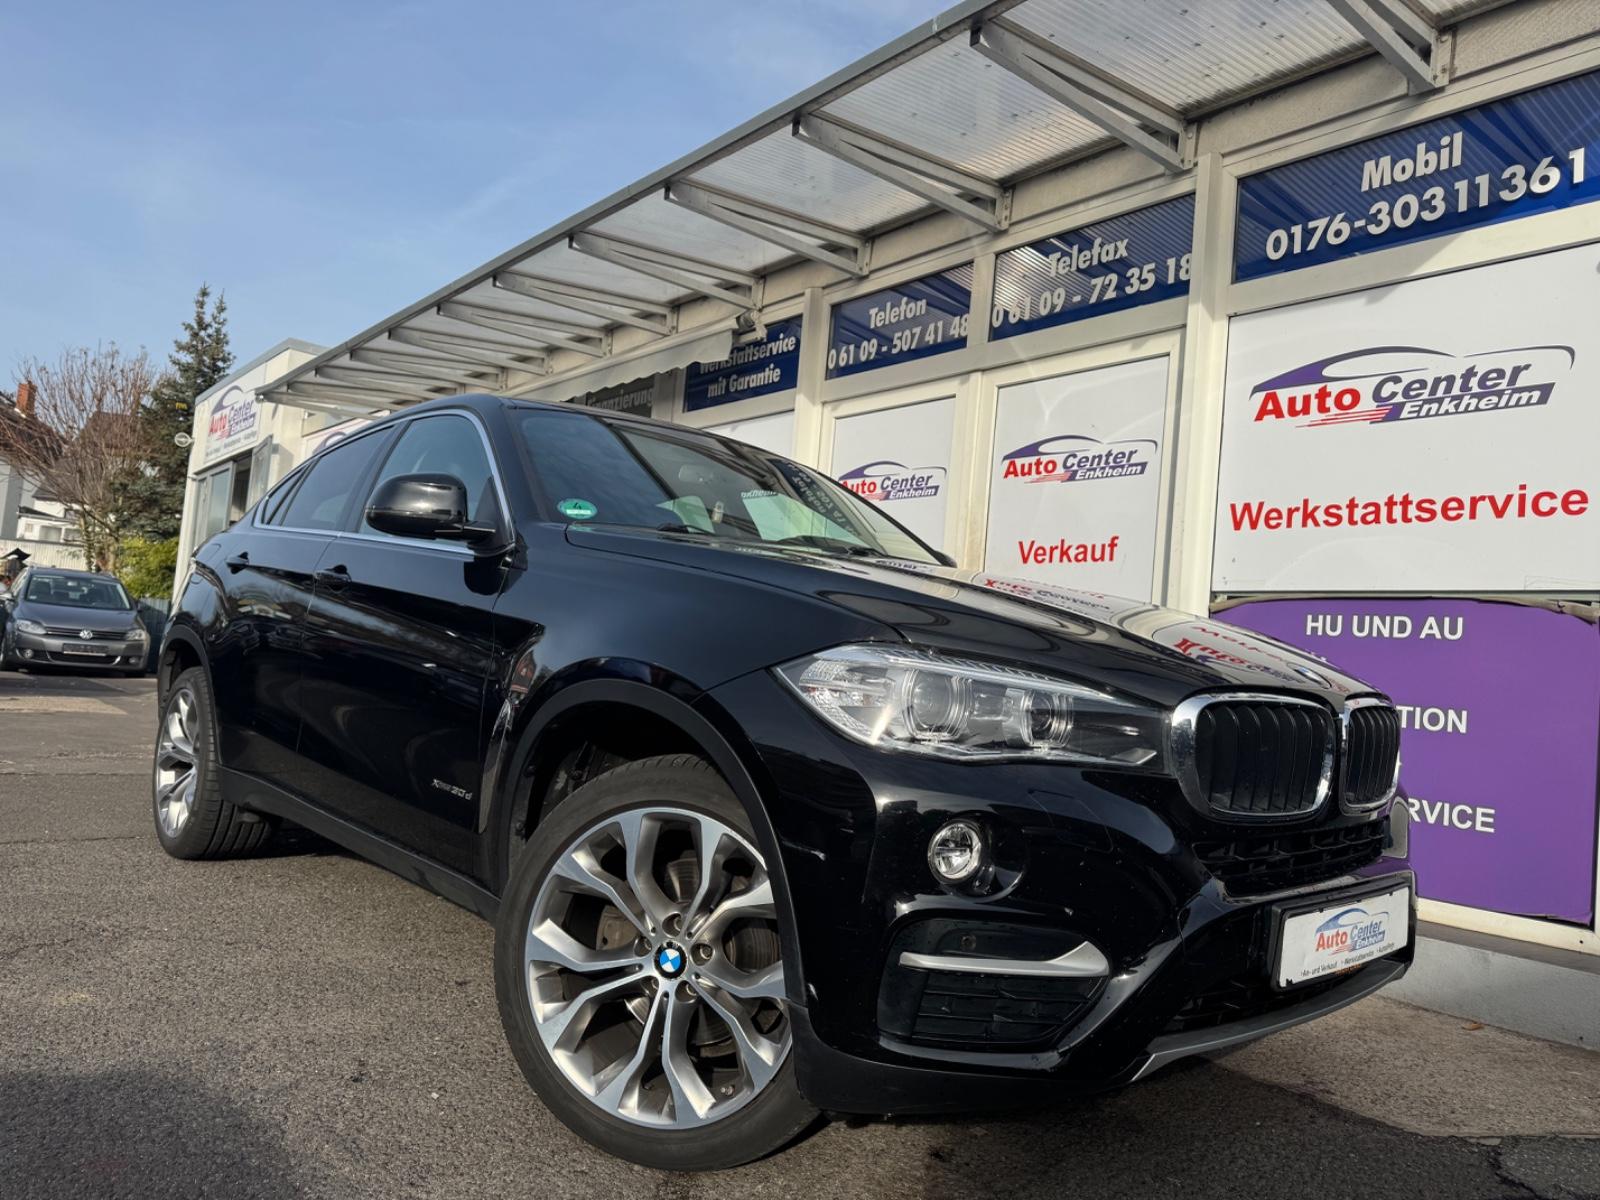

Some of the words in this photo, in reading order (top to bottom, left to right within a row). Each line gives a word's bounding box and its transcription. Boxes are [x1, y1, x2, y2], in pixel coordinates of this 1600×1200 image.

[1361, 131, 1463, 192] Mobil
[1049, 237, 1129, 277] Telefax
[991, 303, 1004, 328] 0
[1008, 295, 1031, 324] 61
[1039, 287, 1066, 316] 09
[1088, 273, 1118, 304] 72
[1125, 262, 1155, 294] 35
[1166, 253, 1192, 284] 18
[869, 296, 927, 329] Telefon
[828, 349, 836, 369] 0
[839, 344, 855, 367] 61
[860, 338, 878, 361] 09
[891, 326, 922, 354] 507
[925, 320, 943, 344] 41
[950, 313, 969, 338] 48
[708, 376, 726, 398] mit
[729, 363, 781, 392] Garantie
[1253, 384, 1361, 422] Auto
[1371, 363, 1532, 404] Center
[1399, 388, 1542, 419] Enkheim
[1003, 457, 1058, 479] Auto
[1062, 449, 1139, 470] Center
[1075, 465, 1142, 480] Enkheim
[881, 473, 933, 490] Center
[889, 488, 936, 499] Enkheim
[1229, 483, 1589, 531] Werkstattservice
[1018, 535, 1120, 565] Verkauf
[1306, 614, 1343, 636] HU
[1352, 615, 1413, 639] UND
[1419, 616, 1463, 641] AU
[1315, 929, 1348, 952] Auto
[1350, 920, 1382, 940] Center
